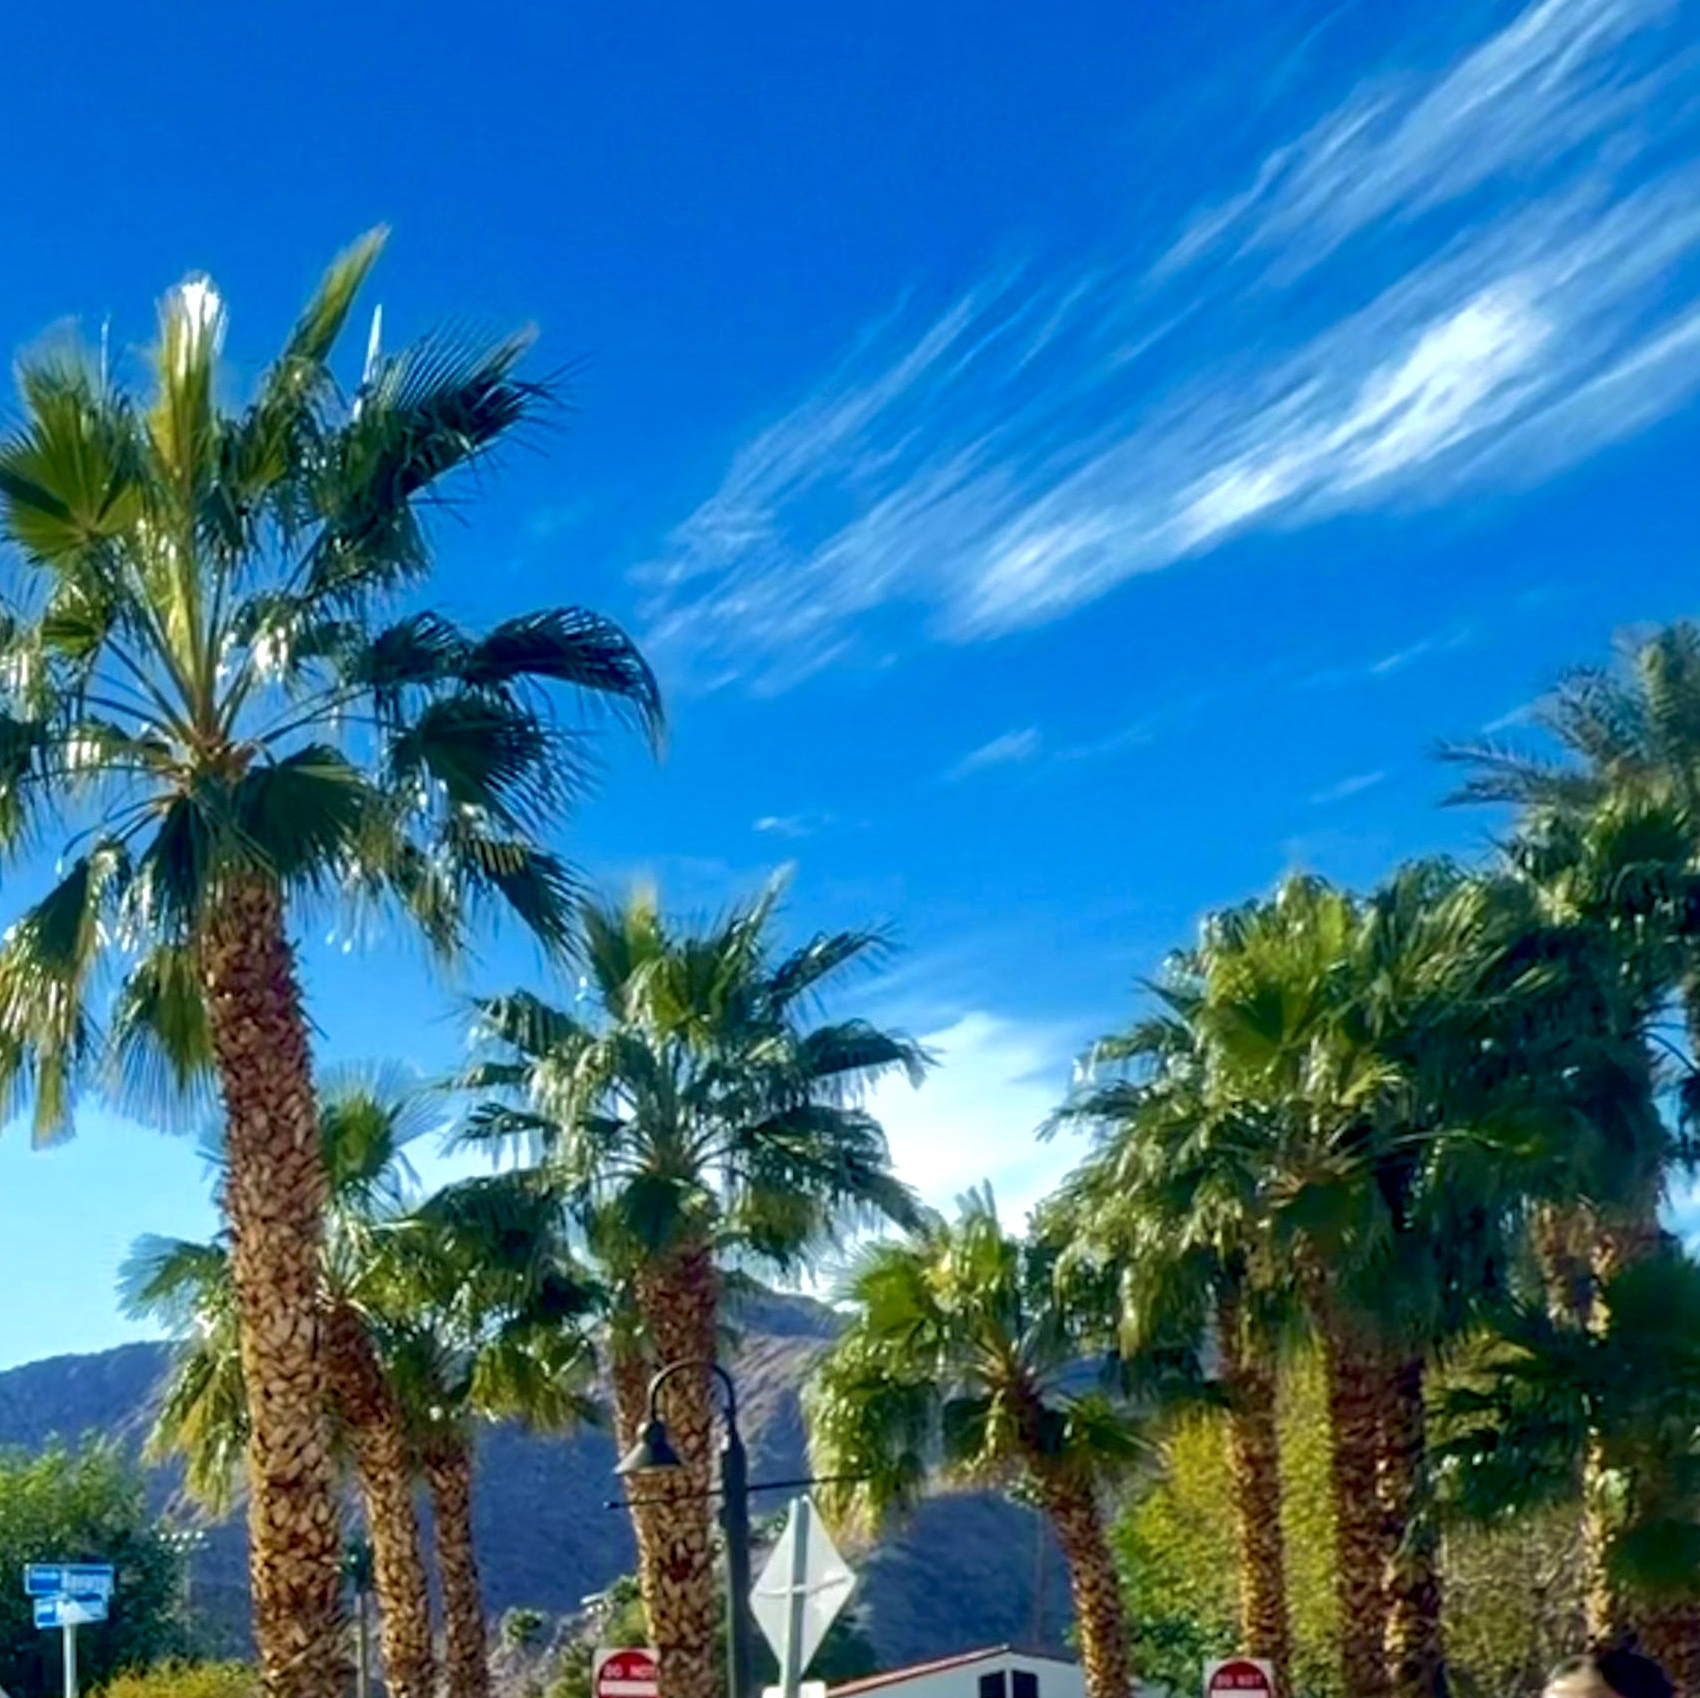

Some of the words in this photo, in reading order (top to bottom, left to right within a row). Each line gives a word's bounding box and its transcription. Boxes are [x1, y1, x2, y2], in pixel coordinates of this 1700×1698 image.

[604, 1664, 623, 1677] DO
[629, 1664, 659, 1677] NOT
[1216, 1674, 1233, 1686] DO
[1237, 1674, 1262, 1686] NOT
